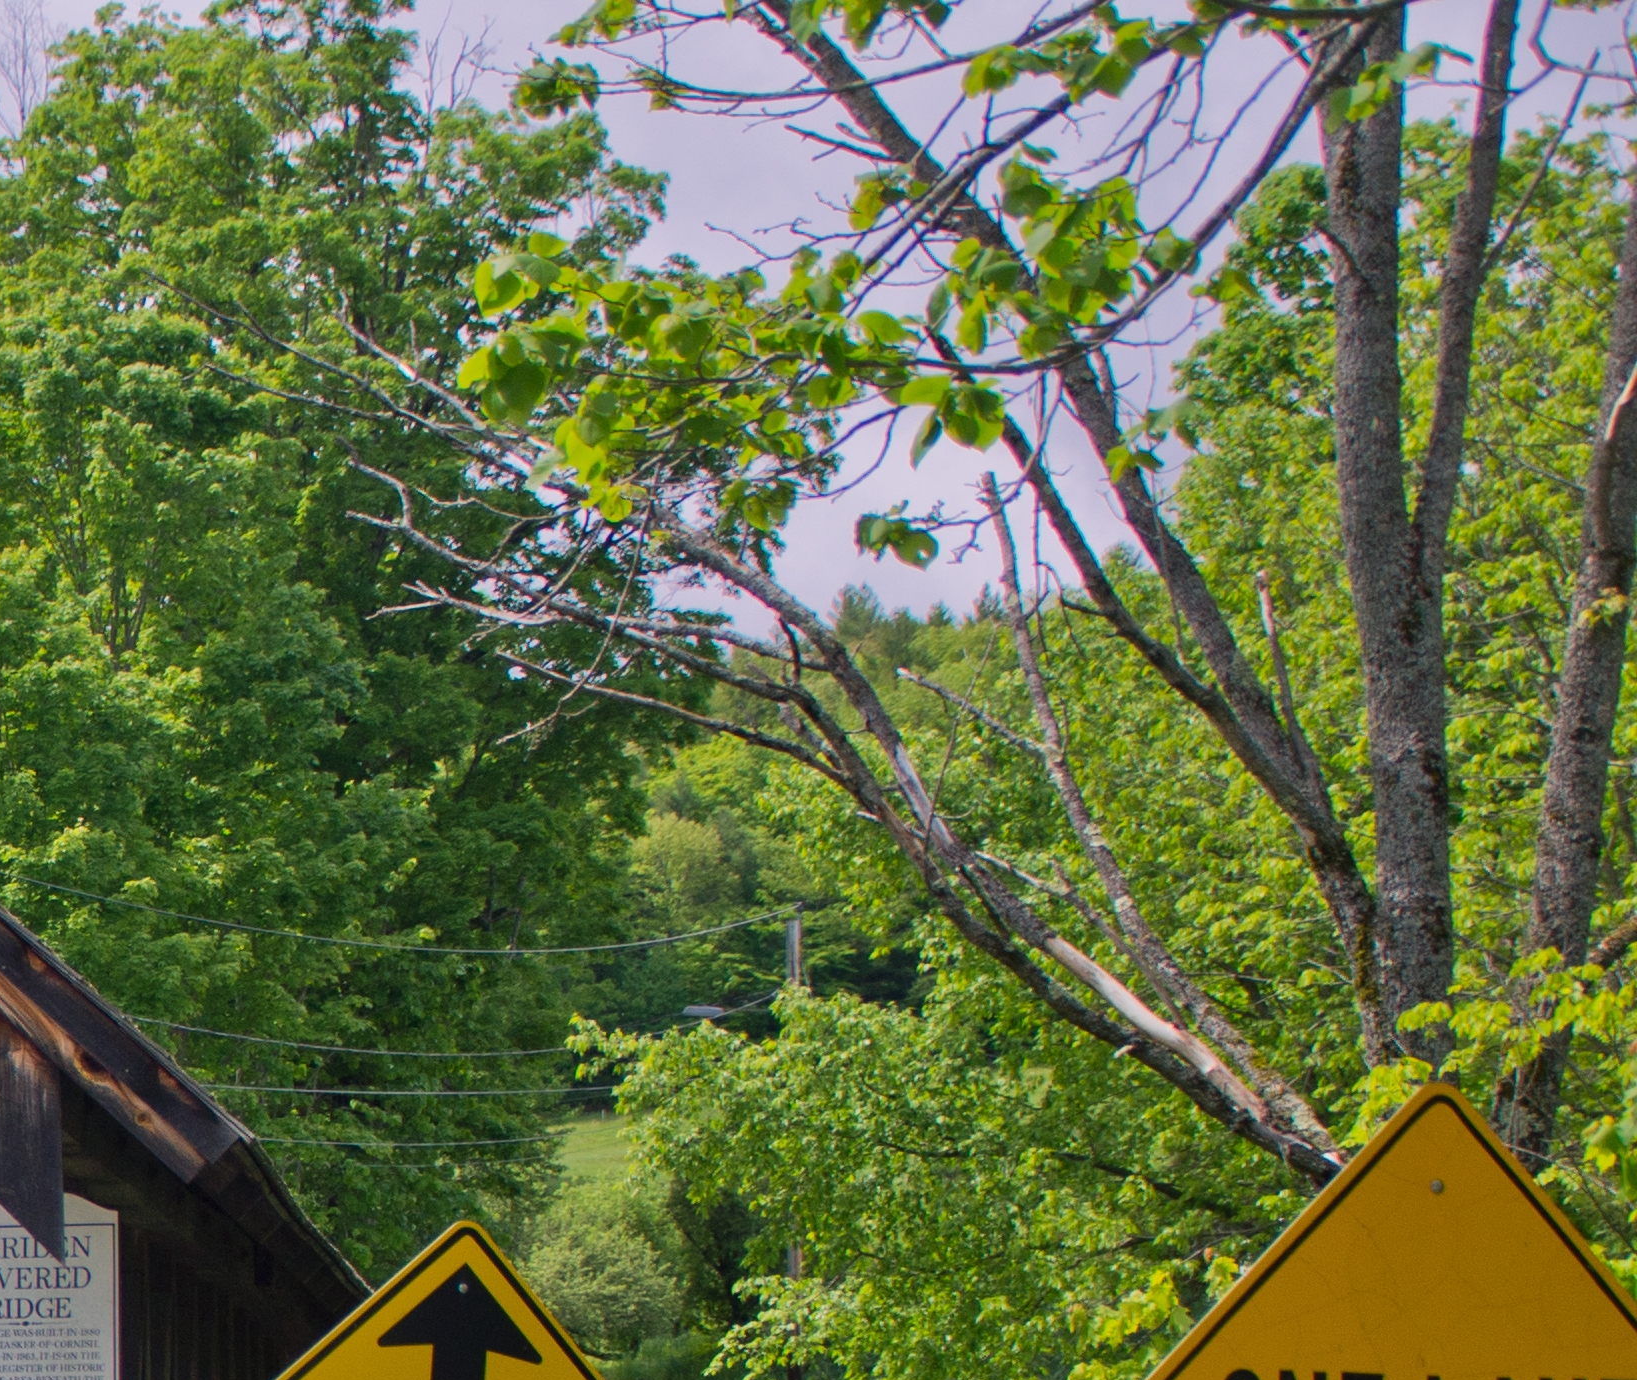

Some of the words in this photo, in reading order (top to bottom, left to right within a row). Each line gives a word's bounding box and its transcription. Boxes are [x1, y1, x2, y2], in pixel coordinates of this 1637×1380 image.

[13, 1328, 34, 1337] WAS
[35, 1328, 64, 1337] BUILT
[66, 1328, 77, 1336] IN
[0, 1340, 36, 1349] TASKER
[39, 1340, 50, 1348] OF
[2, 1352, 13, 1361] IN
[52, 1352, 61, 1360] IS
[63, 1351, 78, 1360] ON
[80, 1351, 101, 1360] THE
[45, 1364, 58, 1372] OF
[60, 1363, 105, 1372] HISTORIC
